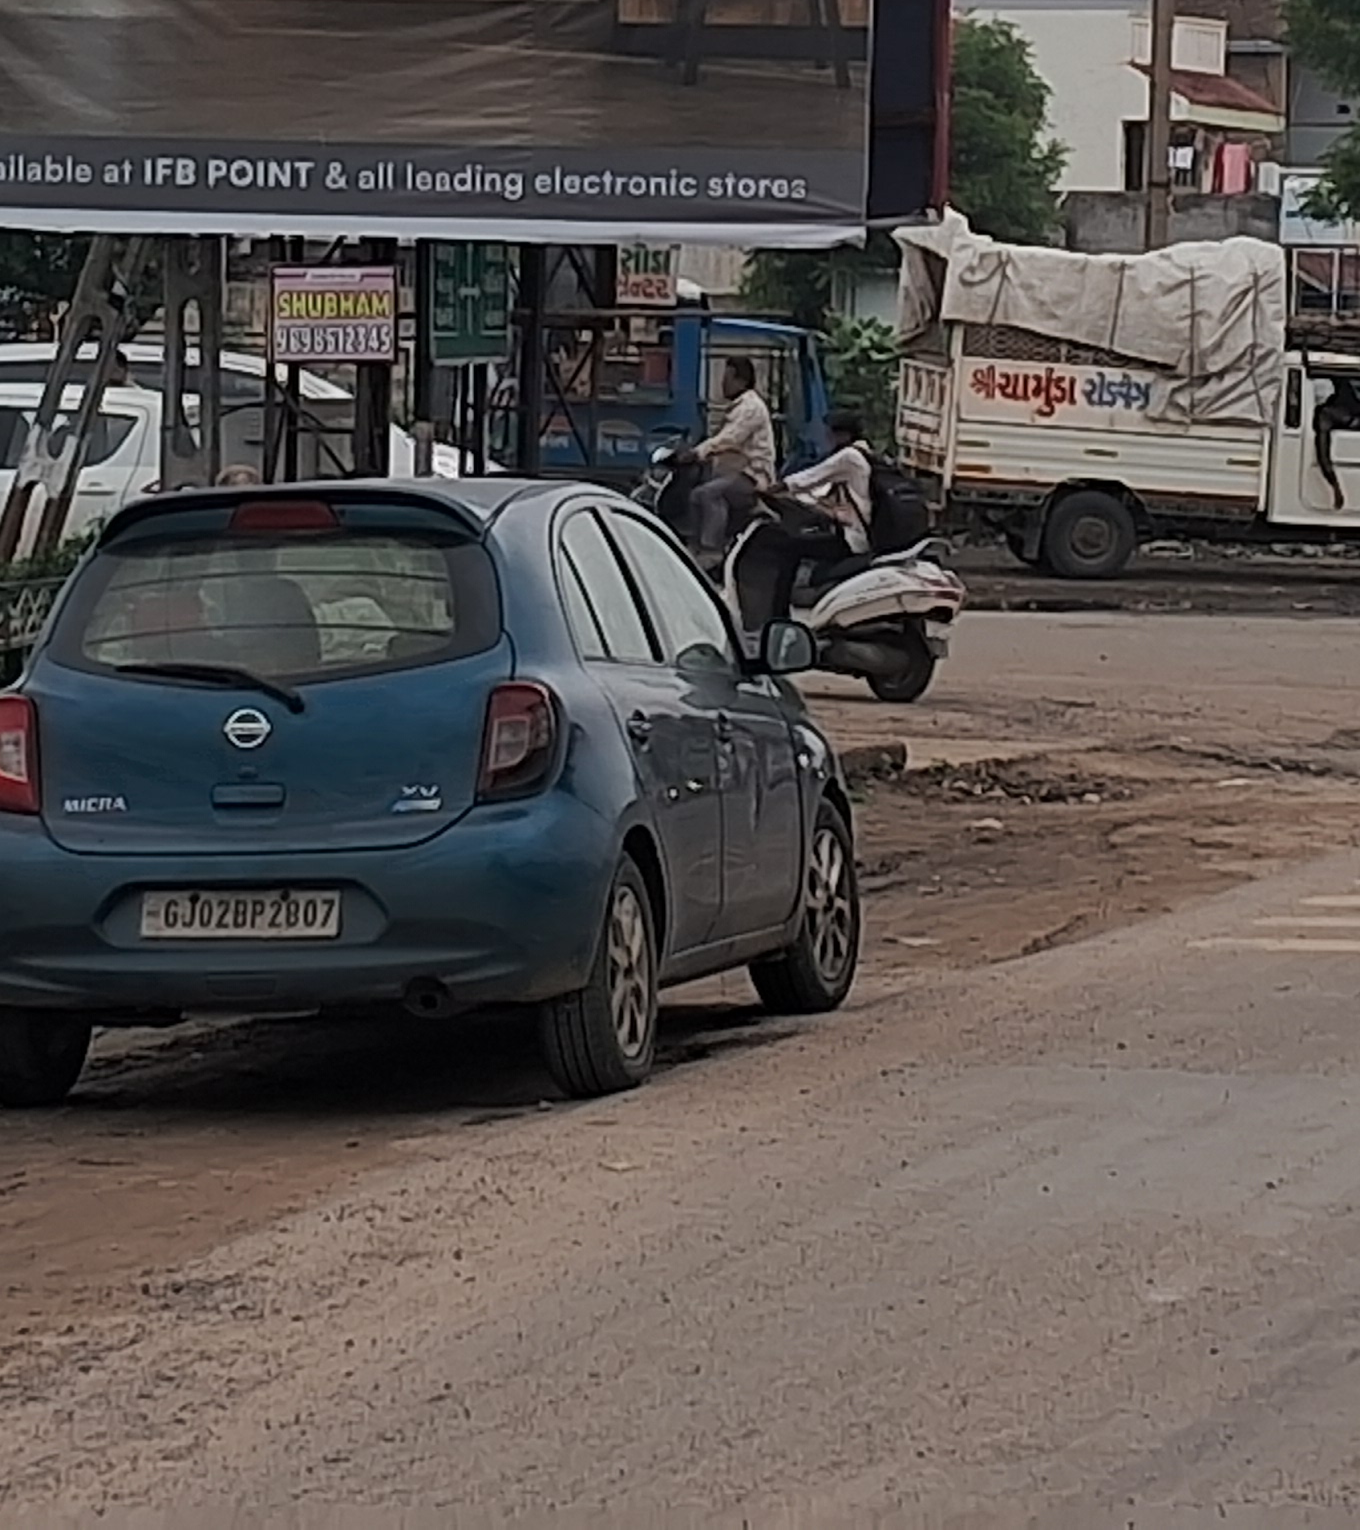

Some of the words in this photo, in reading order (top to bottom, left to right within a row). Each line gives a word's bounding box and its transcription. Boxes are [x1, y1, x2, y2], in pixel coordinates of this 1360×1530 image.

[102, 156, 134, 185] at
[142, 158, 197, 186] IFB
[206, 158, 316, 189] POINT
[324, 160, 349, 190] &
[358, 162, 395, 191] all
[405, 161, 525, 201] leading
[533, 166, 699, 198] electronic
[706, 171, 808, 200] stores
[277, 290, 391, 319] SHUBHAM
[63, 796, 127, 812] MICRA
